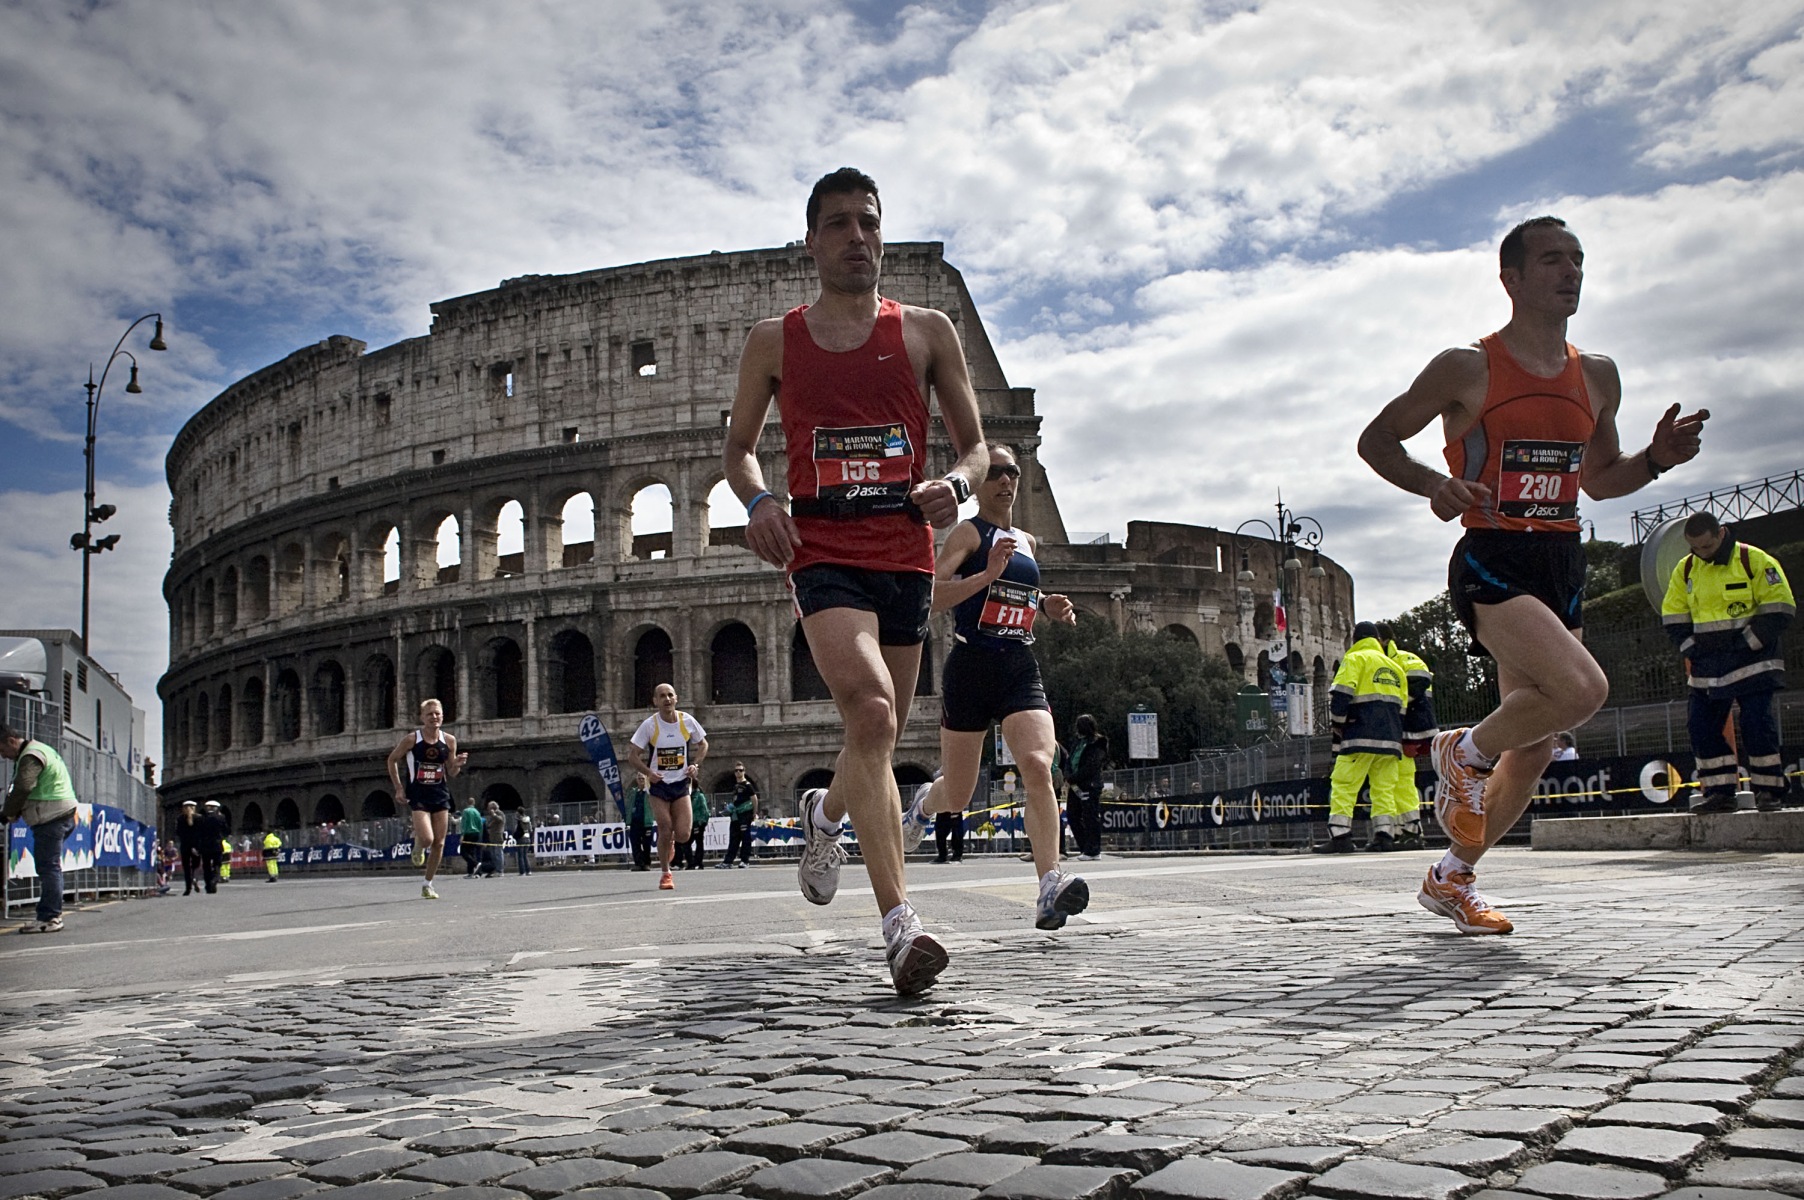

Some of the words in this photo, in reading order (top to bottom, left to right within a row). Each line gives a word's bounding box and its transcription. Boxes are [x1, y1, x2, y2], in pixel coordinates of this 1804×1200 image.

[844, 436, 882, 444] MARATONA
[845, 443, 851, 451] di
[1531, 455, 1538, 463] di
[1532, 449, 1568, 457] MARATONA
[1519, 474, 1562, 500] 230
[581, 718, 601, 738] 42
[661, 757, 679, 765] 1398
[604, 767, 618, 781] 42
[1534, 767, 1612, 805] mart
[1263, 788, 1311, 818] smart
[1103, 805, 1147, 829] smart
[537, 829, 577, 853] ROMA
[582, 828, 596, 850] E'
